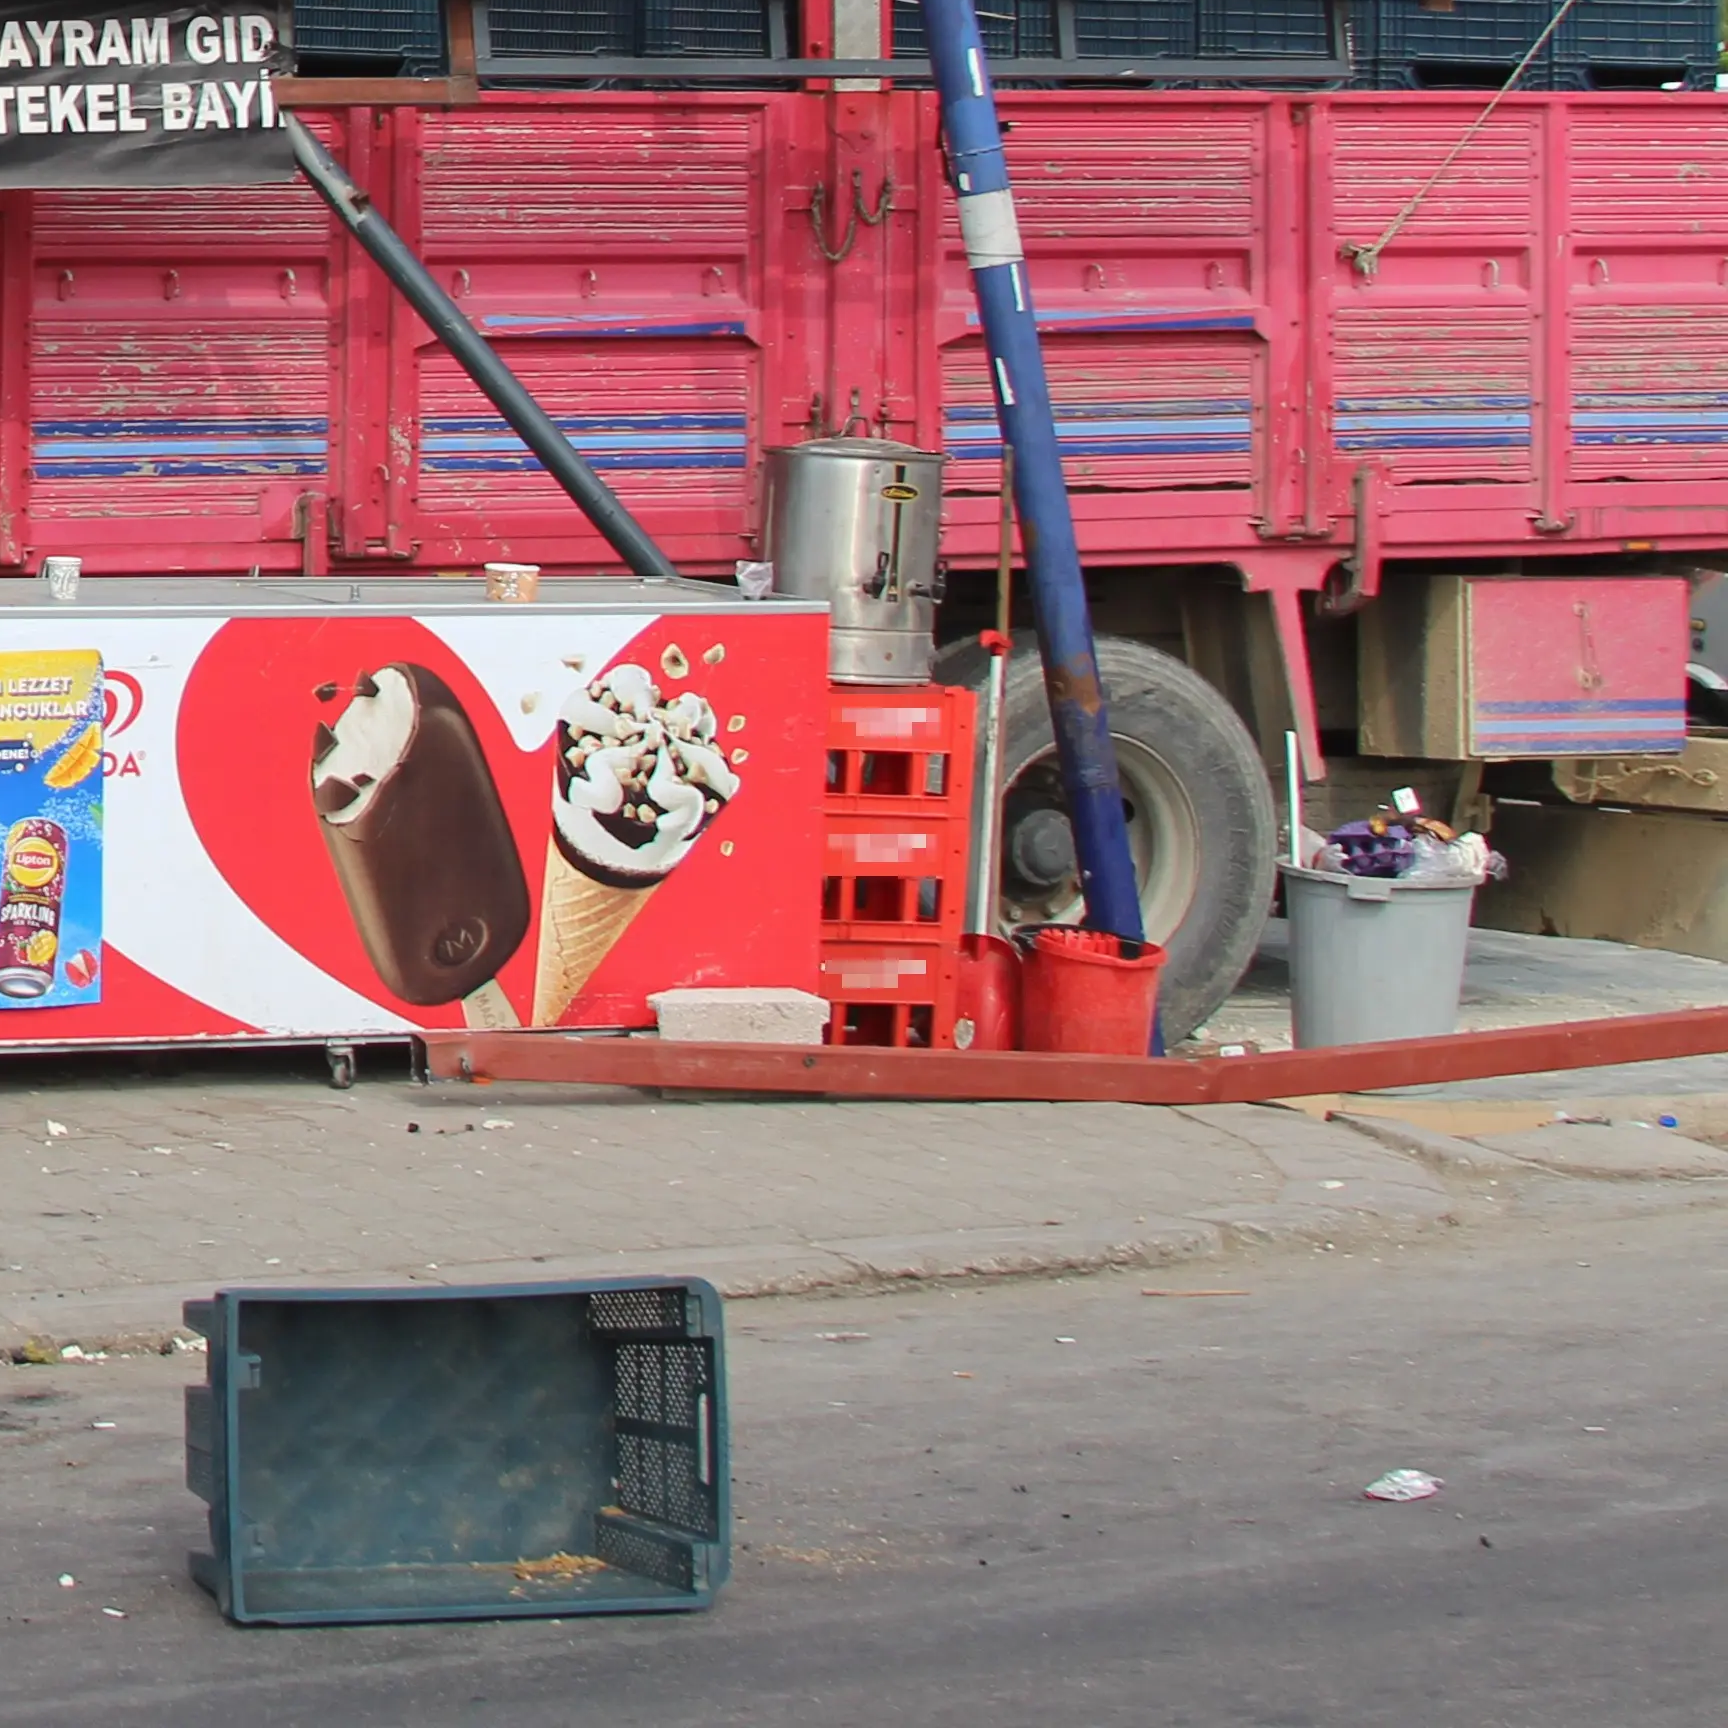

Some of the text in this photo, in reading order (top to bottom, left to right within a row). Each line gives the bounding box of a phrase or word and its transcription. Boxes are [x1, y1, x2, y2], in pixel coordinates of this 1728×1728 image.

[161, 69, 287, 132] BAYİ
[8, 676, 72, 696] LEZZET
[15, 853, 51, 866] Lipton
